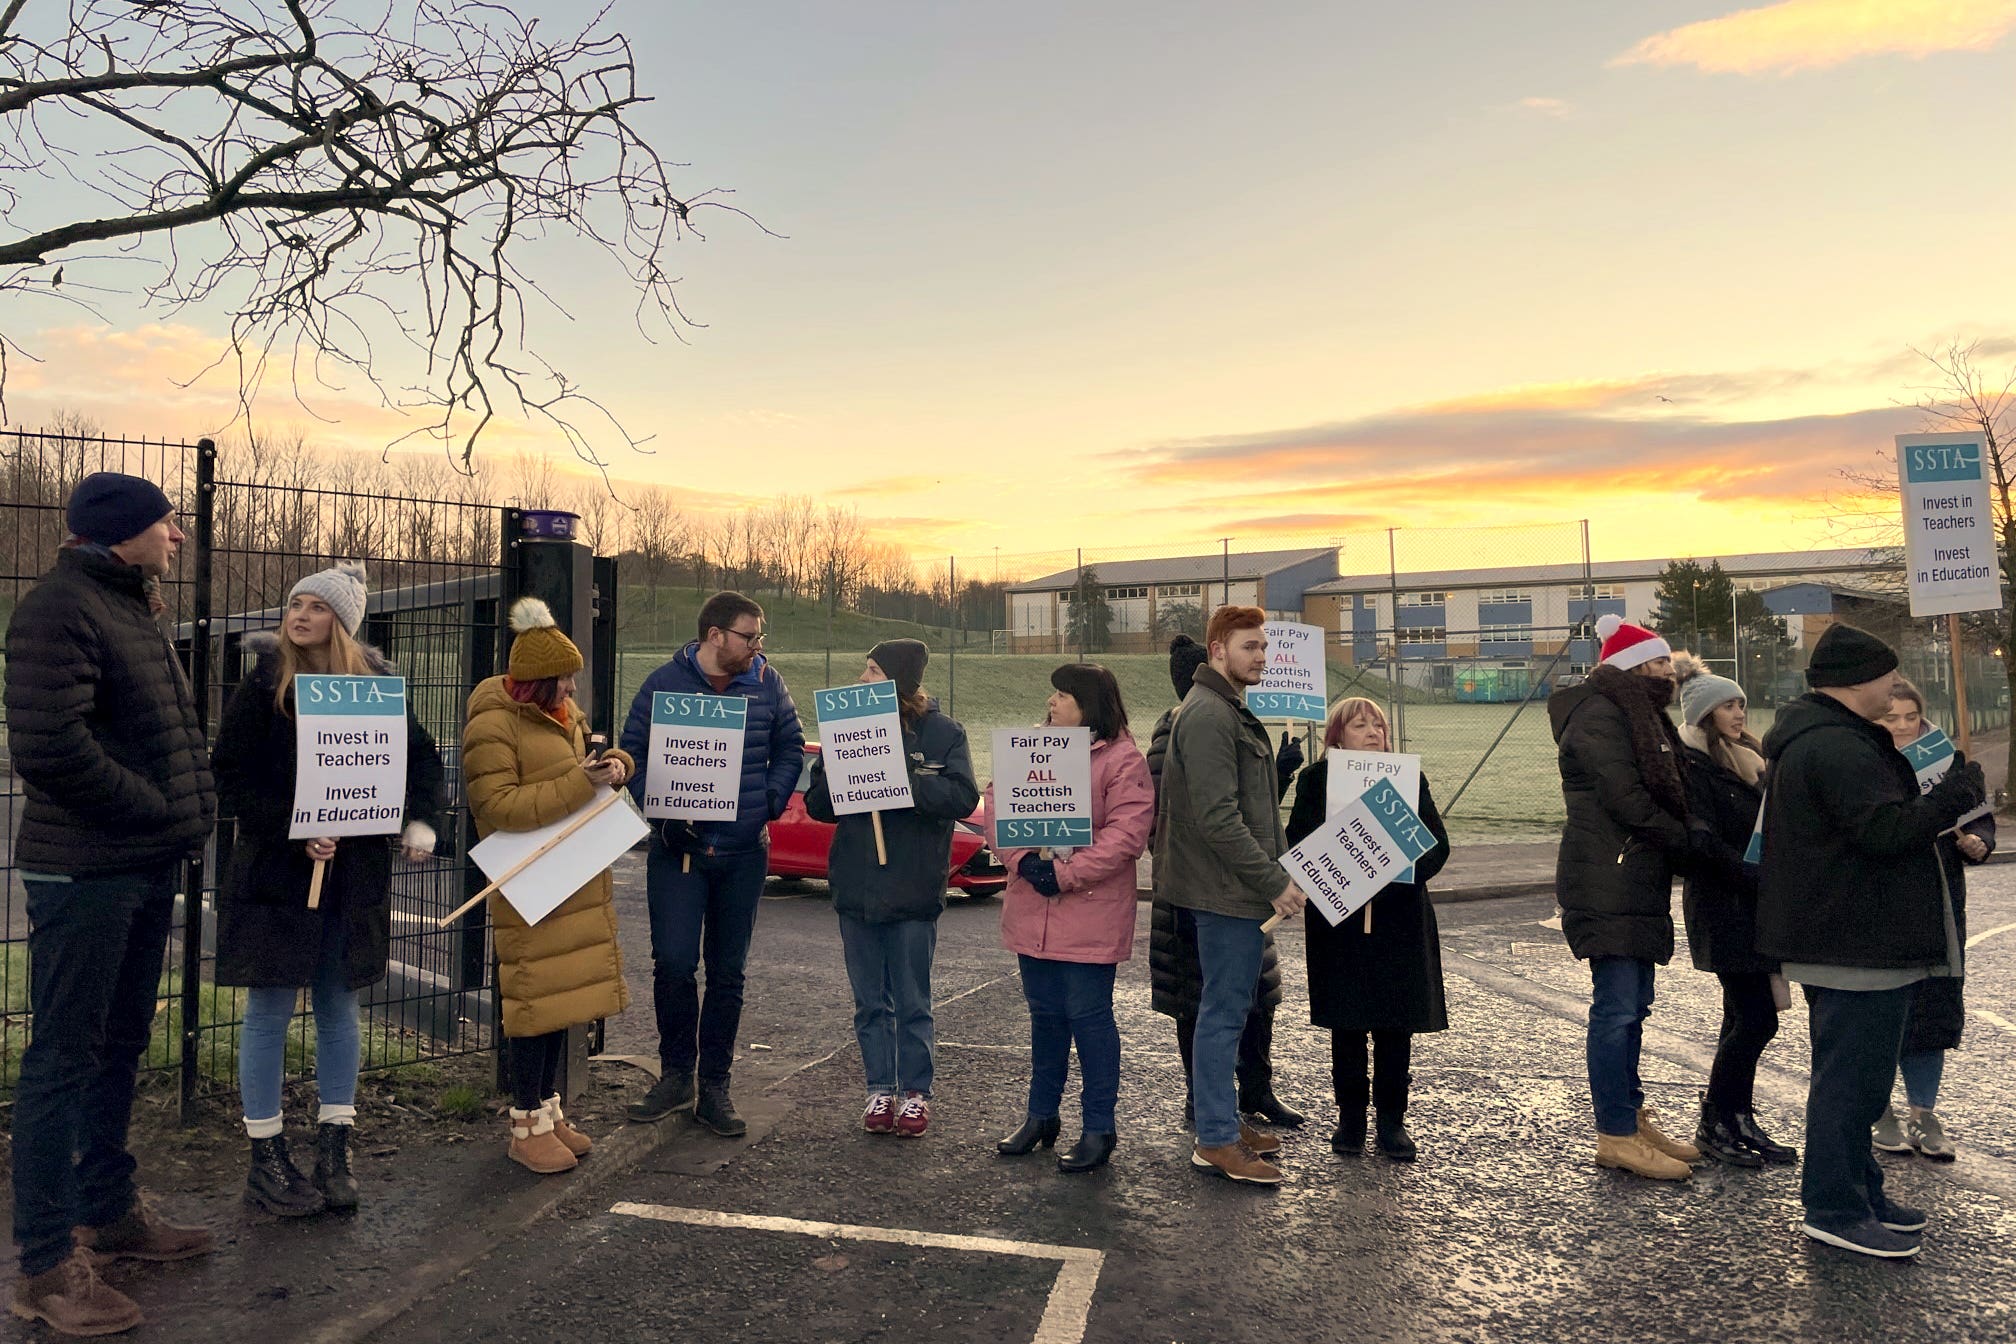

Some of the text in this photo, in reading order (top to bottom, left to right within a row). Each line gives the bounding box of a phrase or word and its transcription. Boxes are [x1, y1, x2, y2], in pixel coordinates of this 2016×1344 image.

[1914, 448, 1966, 470] SSTA
[1923, 494, 1972, 510] Invest in
[1923, 516, 1975, 530] Teachers
[1934, 546, 1970, 561] Invest
[1918, 565, 1990, 583] in Education
[1289, 629, 1309, 640] Pay
[1278, 640, 1295, 650] for
[1274, 654, 1299, 664] ALL
[1262, 666, 1310, 678] Scottish
[310, 680, 384, 702] SSTA
[1260, 679, 1313, 690] Teachers
[664, 696, 727, 718] SSTA
[825, 688, 880, 711] SSTA
[1256, 694, 1309, 710] SSTA
[317, 730, 388, 744] Invest in
[834, 726, 887, 744] Invest in
[1011, 736, 1070, 749] Fair Pay
[666, 737, 727, 751] Invest in
[316, 752, 390, 766] Teachers
[835, 744, 890, 760] Teachers
[1030, 752, 1052, 764] for
[663, 754, 727, 768] Teachers
[1348, 760, 1400, 776] Fair Pay
[848, 770, 886, 785] Invest
[1026, 770, 1056, 782] ALL
[1364, 777, 1376, 788] fo
[326, 785, 377, 800] Invest
[670, 780, 714, 792] Invest
[1012, 786, 1072, 798] Scottish
[646, 795, 735, 810] in Education
[832, 786, 908, 804] in Education
[295, 804, 400, 823] in Education
[1010, 802, 1076, 813] Teachers
[1376, 788, 1420, 843] SSTA
[1008, 820, 1072, 838] SSTA
[1350, 818, 1390, 868] Invest in
[1336, 828, 1378, 880] Teachers
[1318, 852, 1351, 890] Invest
[1290, 846, 1350, 918] in Education
